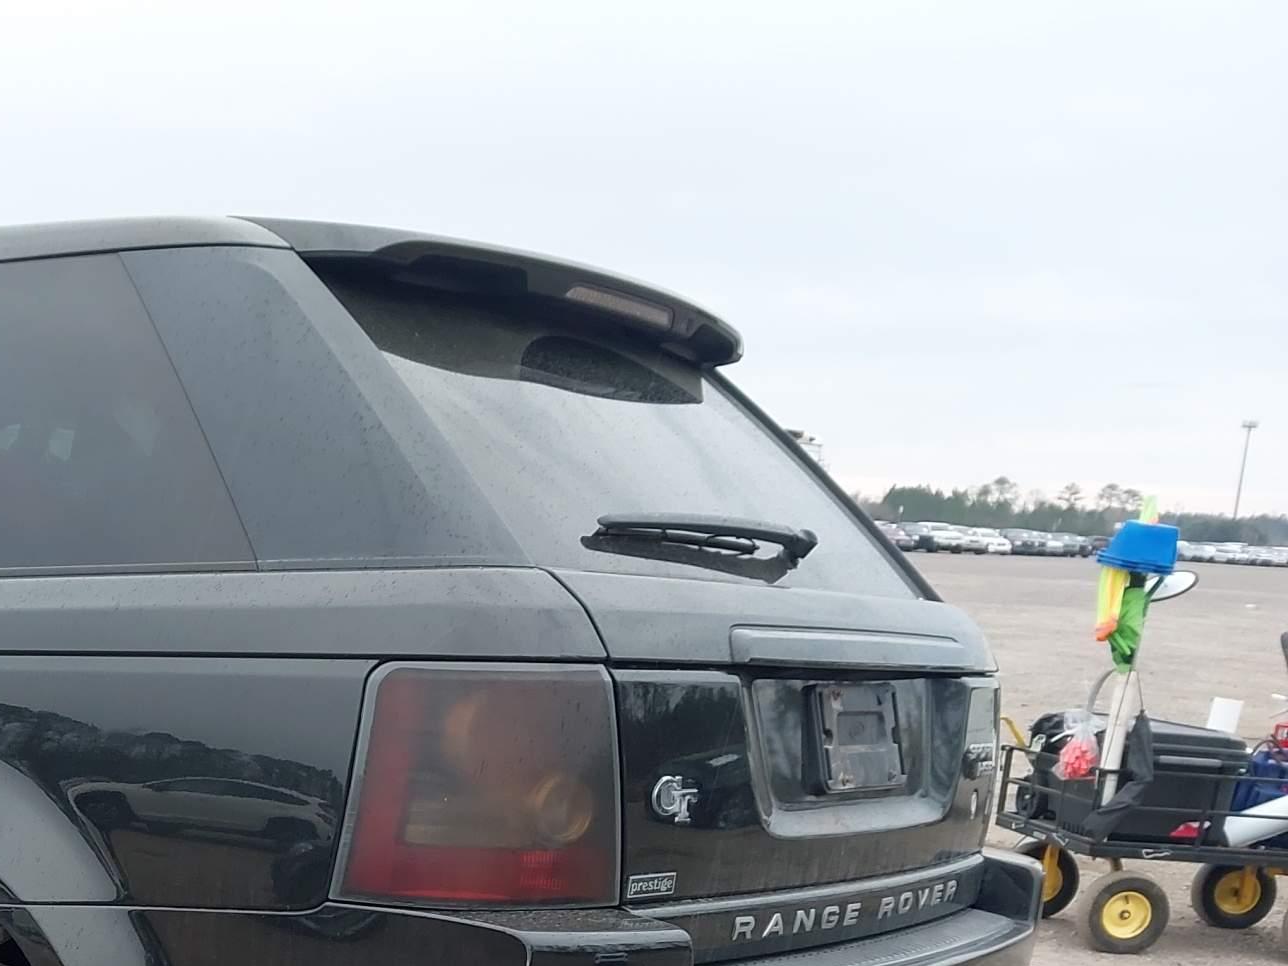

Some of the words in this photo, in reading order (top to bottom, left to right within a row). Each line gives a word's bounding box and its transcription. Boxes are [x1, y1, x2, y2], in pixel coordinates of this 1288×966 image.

[630, 877, 674, 895] prestige
[732, 901, 863, 941] RANGE
[877, 879, 959, 920] ROVER
